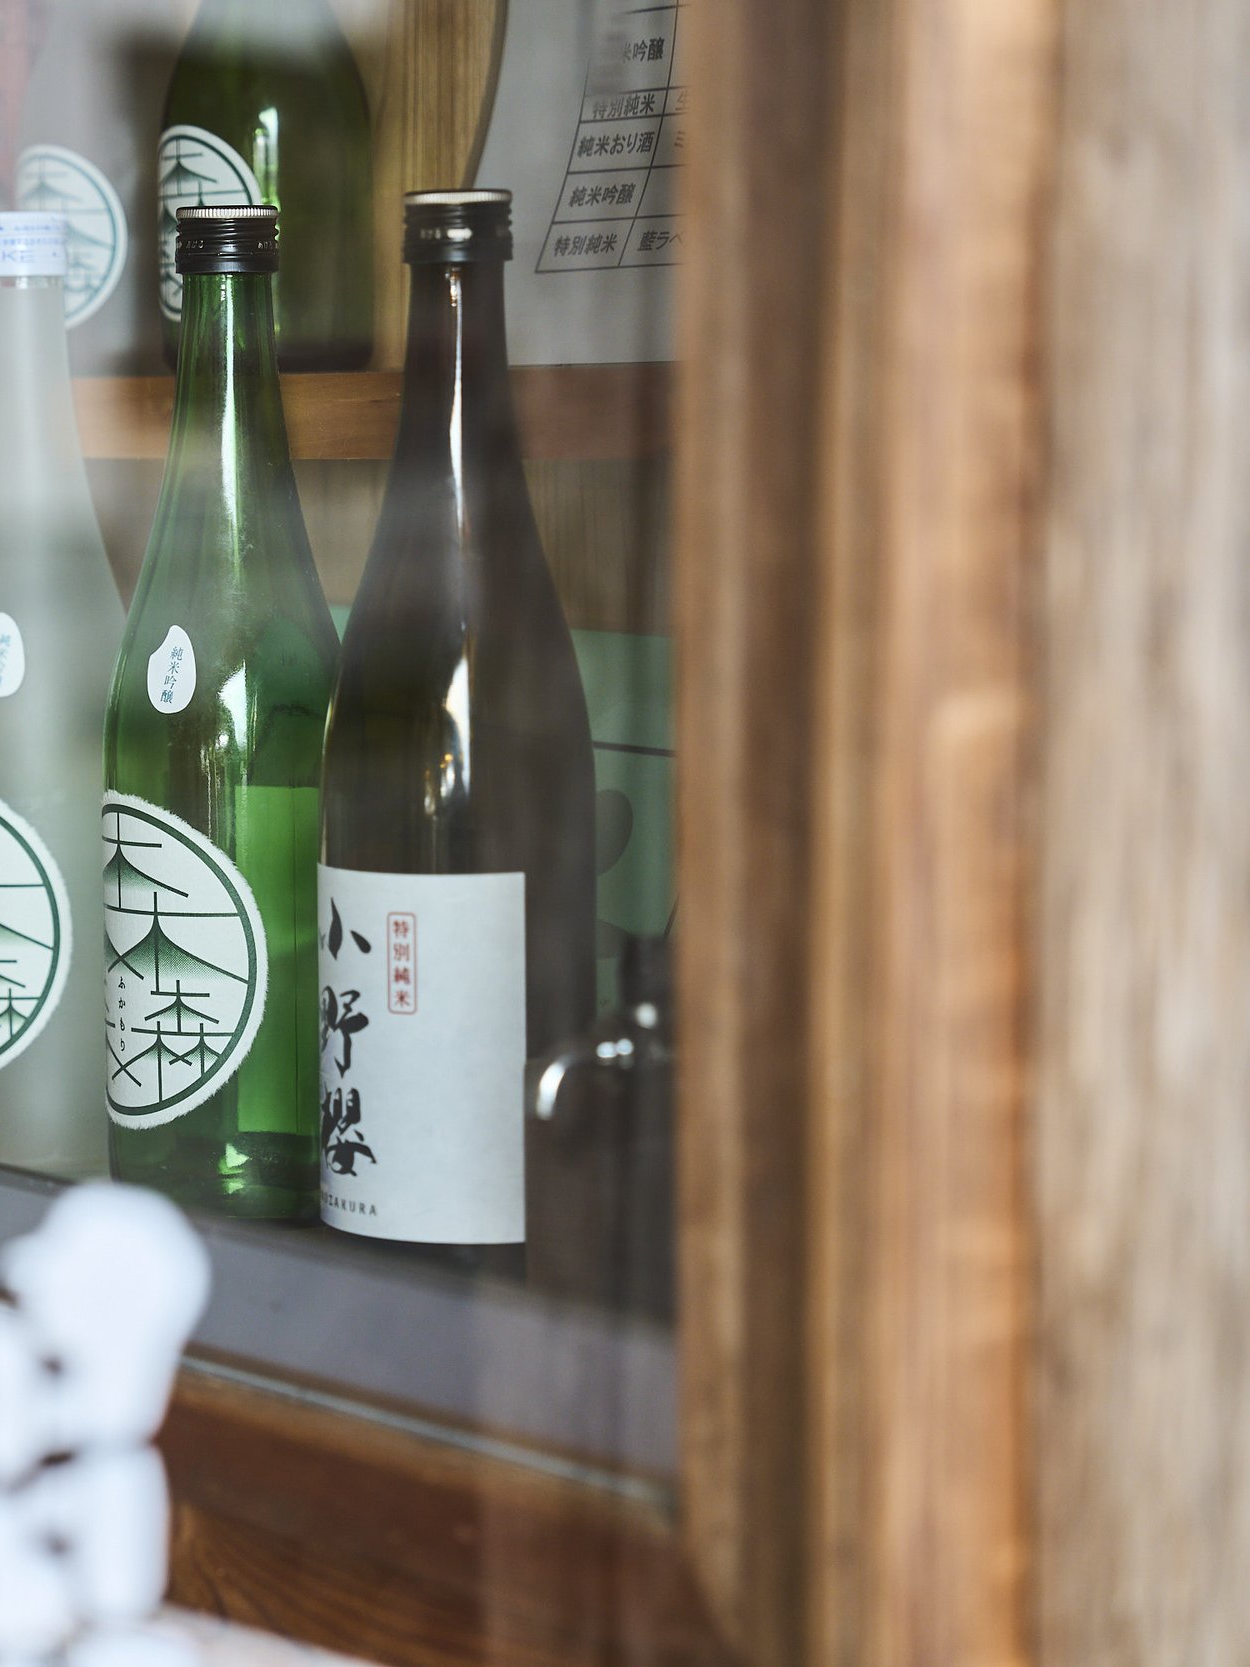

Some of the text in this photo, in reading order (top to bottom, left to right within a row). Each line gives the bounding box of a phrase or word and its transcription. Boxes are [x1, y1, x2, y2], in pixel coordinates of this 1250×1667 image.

[592, 93, 656, 119] 特別純米
[577, 131, 655, 158] 純米おり酒
[568, 182, 636, 208] 純米吟醸
[553, 233, 618, 257] 特別純米
[160, 646, 184, 704] 純米吟醸
[393, 919, 411, 1008] 特別純米
[118, 976, 126, 1052] ふかもり
